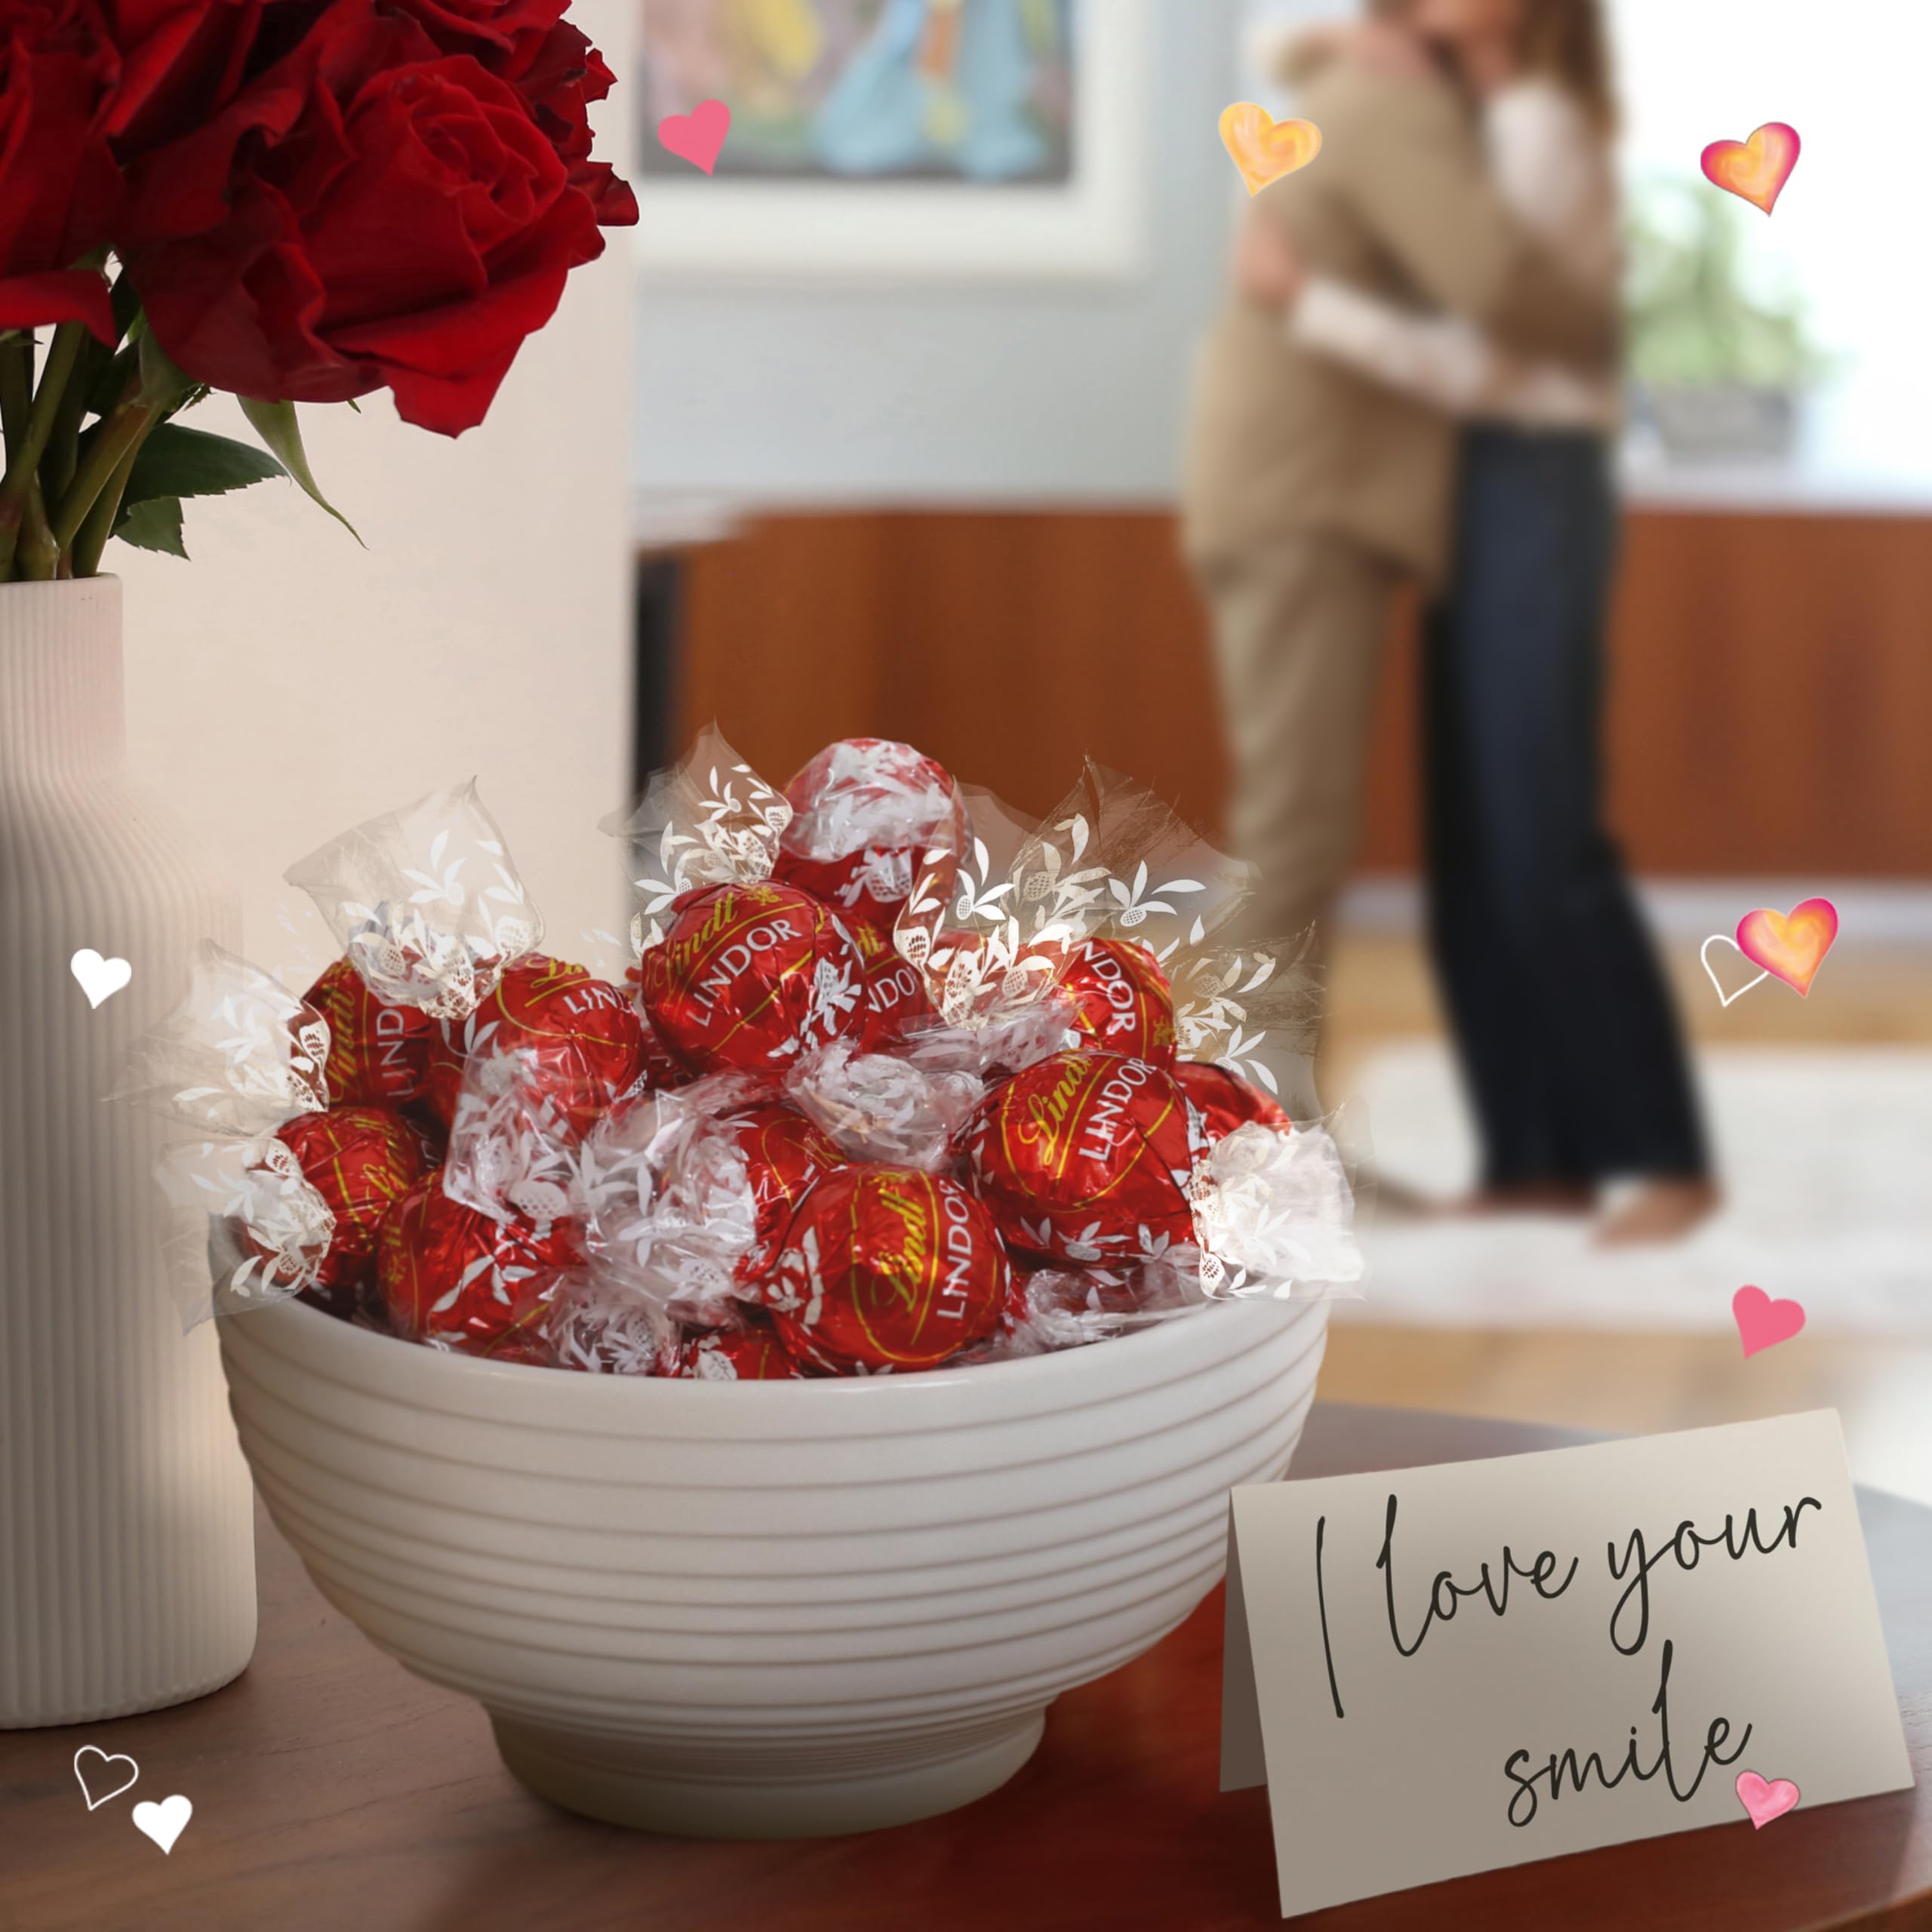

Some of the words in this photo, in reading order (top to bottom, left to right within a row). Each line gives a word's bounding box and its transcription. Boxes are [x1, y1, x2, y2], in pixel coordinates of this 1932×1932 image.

[685, 918, 803, 1027] LINDOR
[1071, 940, 1137, 1035] NDOR
[376, 1008, 414, 1097] LIND
[1078, 1057, 1158, 1161] LINDOR
[1316, 1515, 1345, 1719] I
[1376, 1494, 1579, 1657] love
[1607, 1497, 1822, 1656] your
[1504, 1638, 1753, 1827] smile
